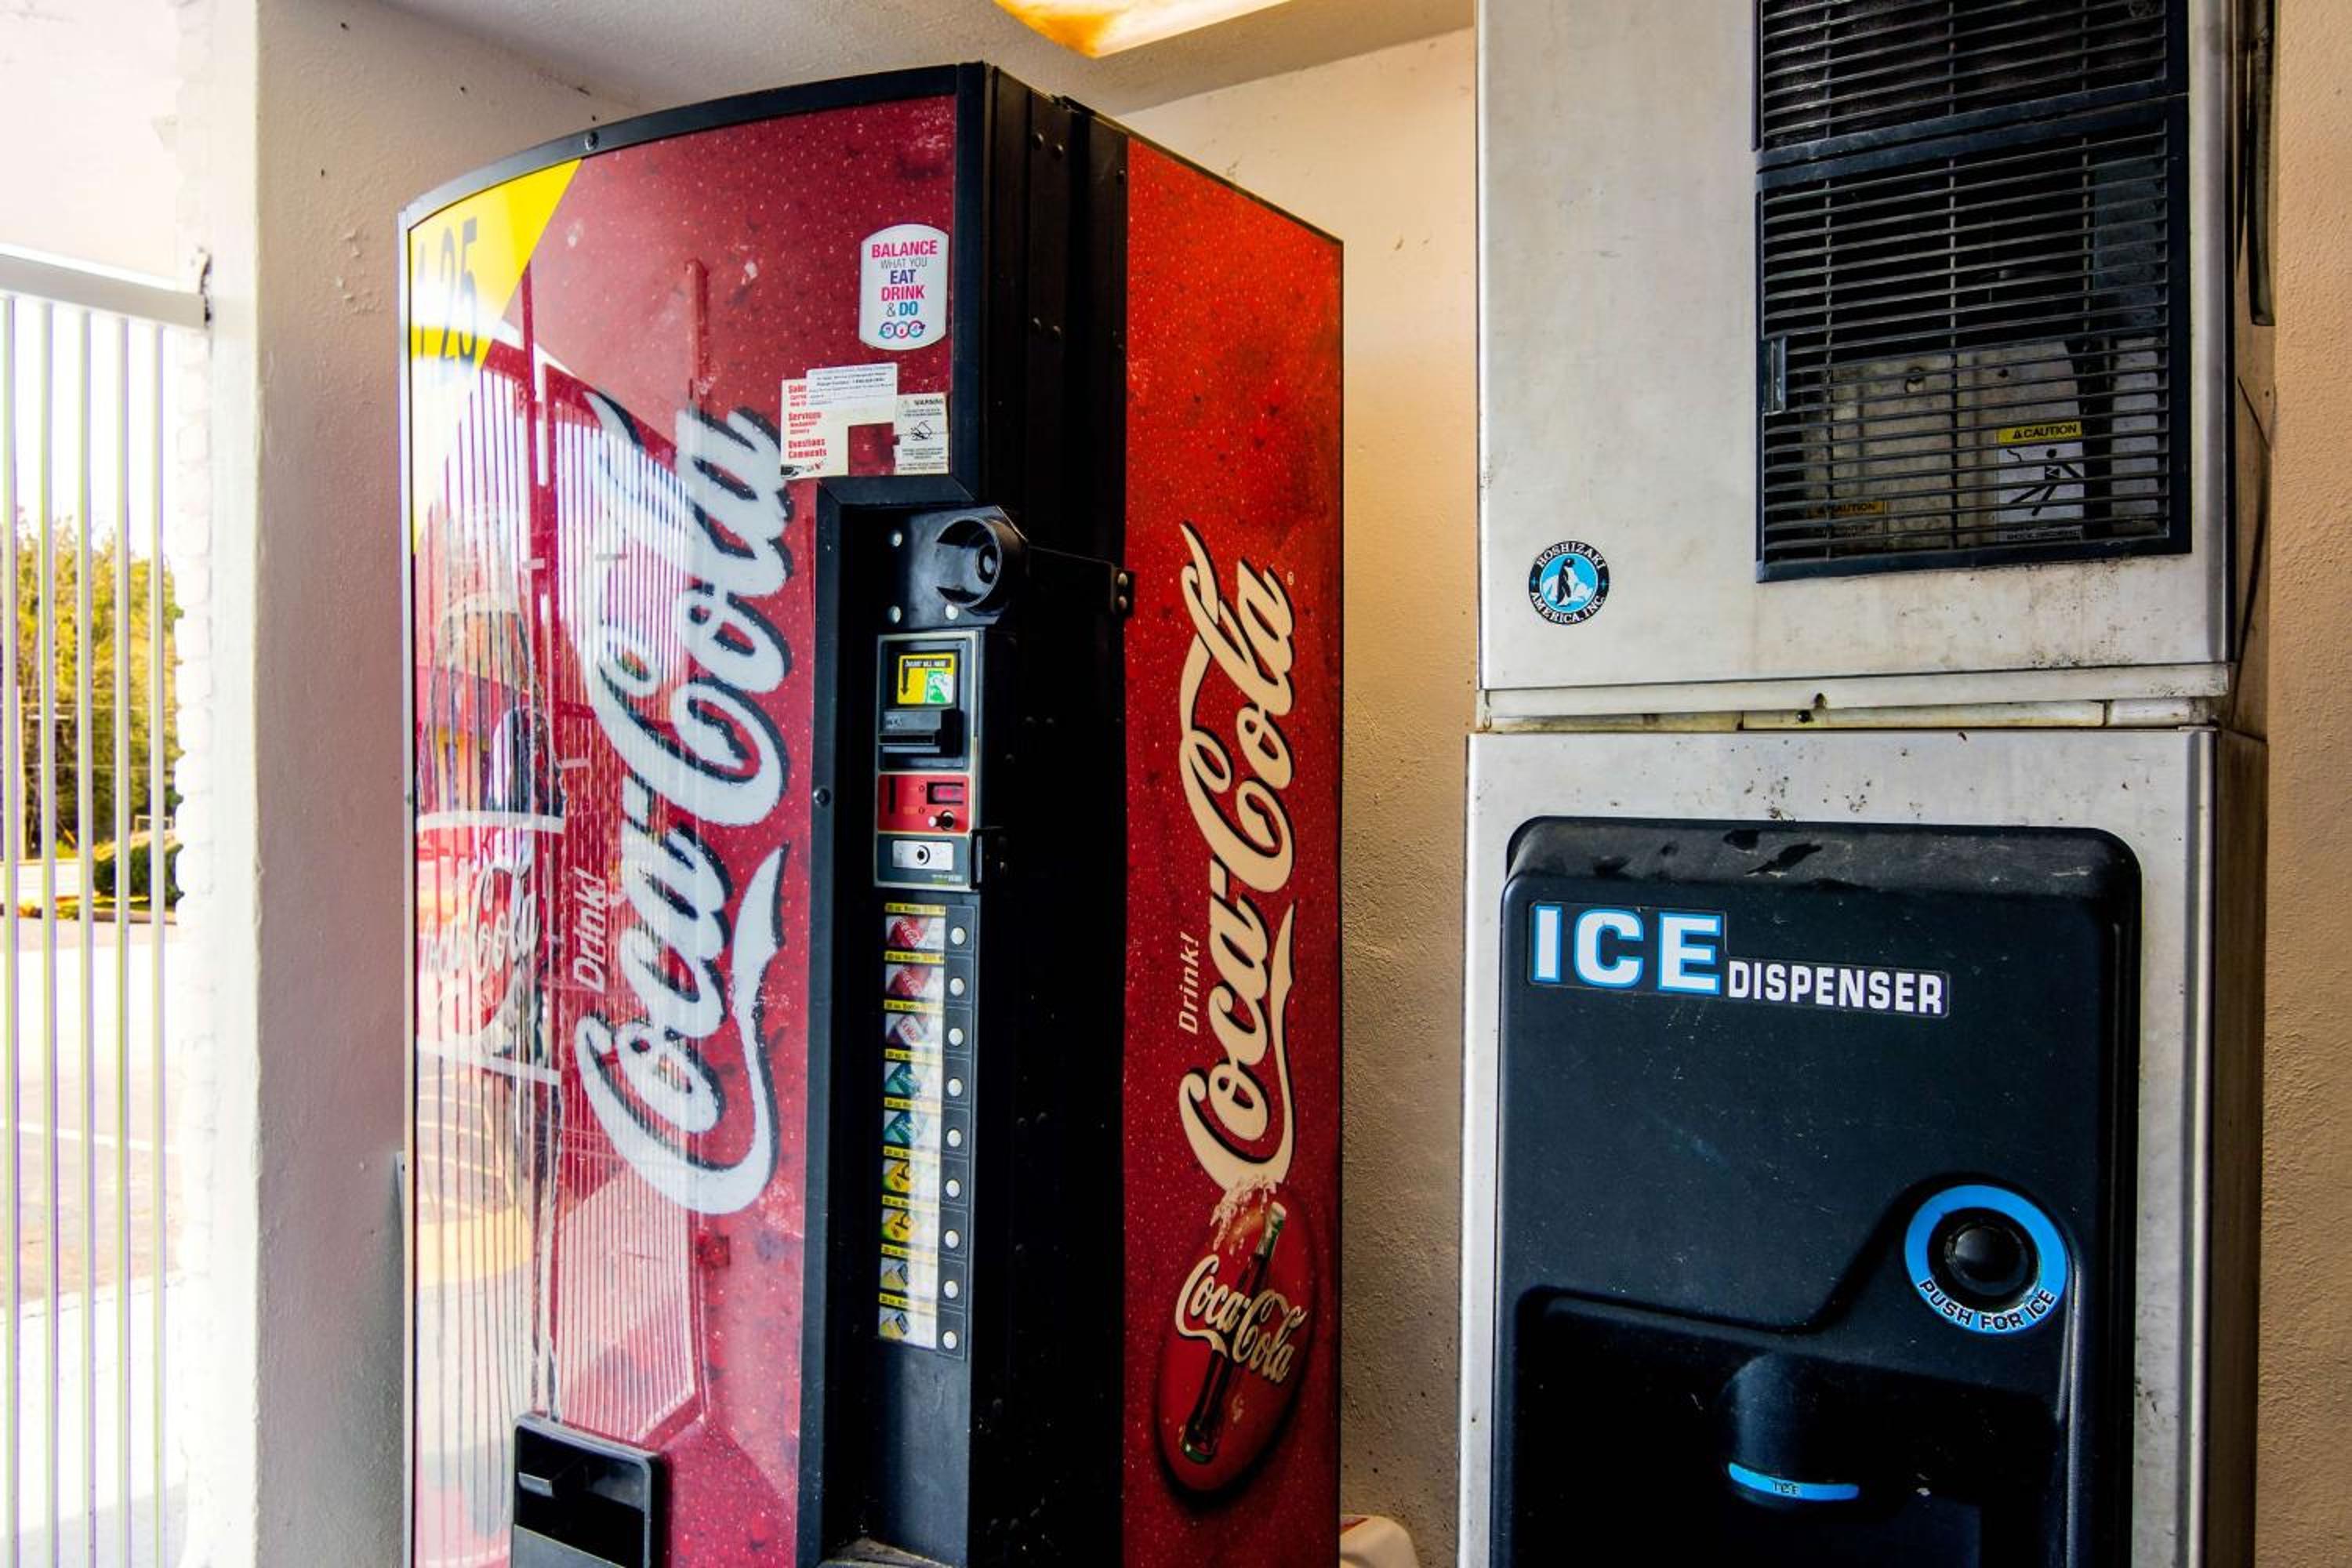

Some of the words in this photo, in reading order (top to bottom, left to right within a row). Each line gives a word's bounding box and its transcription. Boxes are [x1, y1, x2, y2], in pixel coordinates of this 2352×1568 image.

[872, 240, 938, 258] BALANCE
[880, 259, 906, 269] WHAT
[909, 257, 927, 267] YOU
[890, 269, 916, 284] EAT
[880, 285, 925, 301] DRINK
[886, 303, 895, 317] &
[899, 301, 918, 316] DO
[2024, 424, 2077, 439] CAUTION
[788, 448, 828, 459] Comments
[1537, 542, 1607, 568] HOSHIZAKI
[1179, 522, 1294, 1192] Coca-Cola
[573, 866, 606, 993] Drink!
[1534, 905, 1722, 995] ICE
[1178, 931, 1199, 1035] Drink!
[1728, 960, 1944, 1014] DISPENSER
[1919, 1278, 1974, 1327] PUSH
[1980, 1313, 2025, 1331] FOR
[2024, 1288, 2056, 1320] ICE
[1175, 1254, 1307, 1384] Coca-Cola
